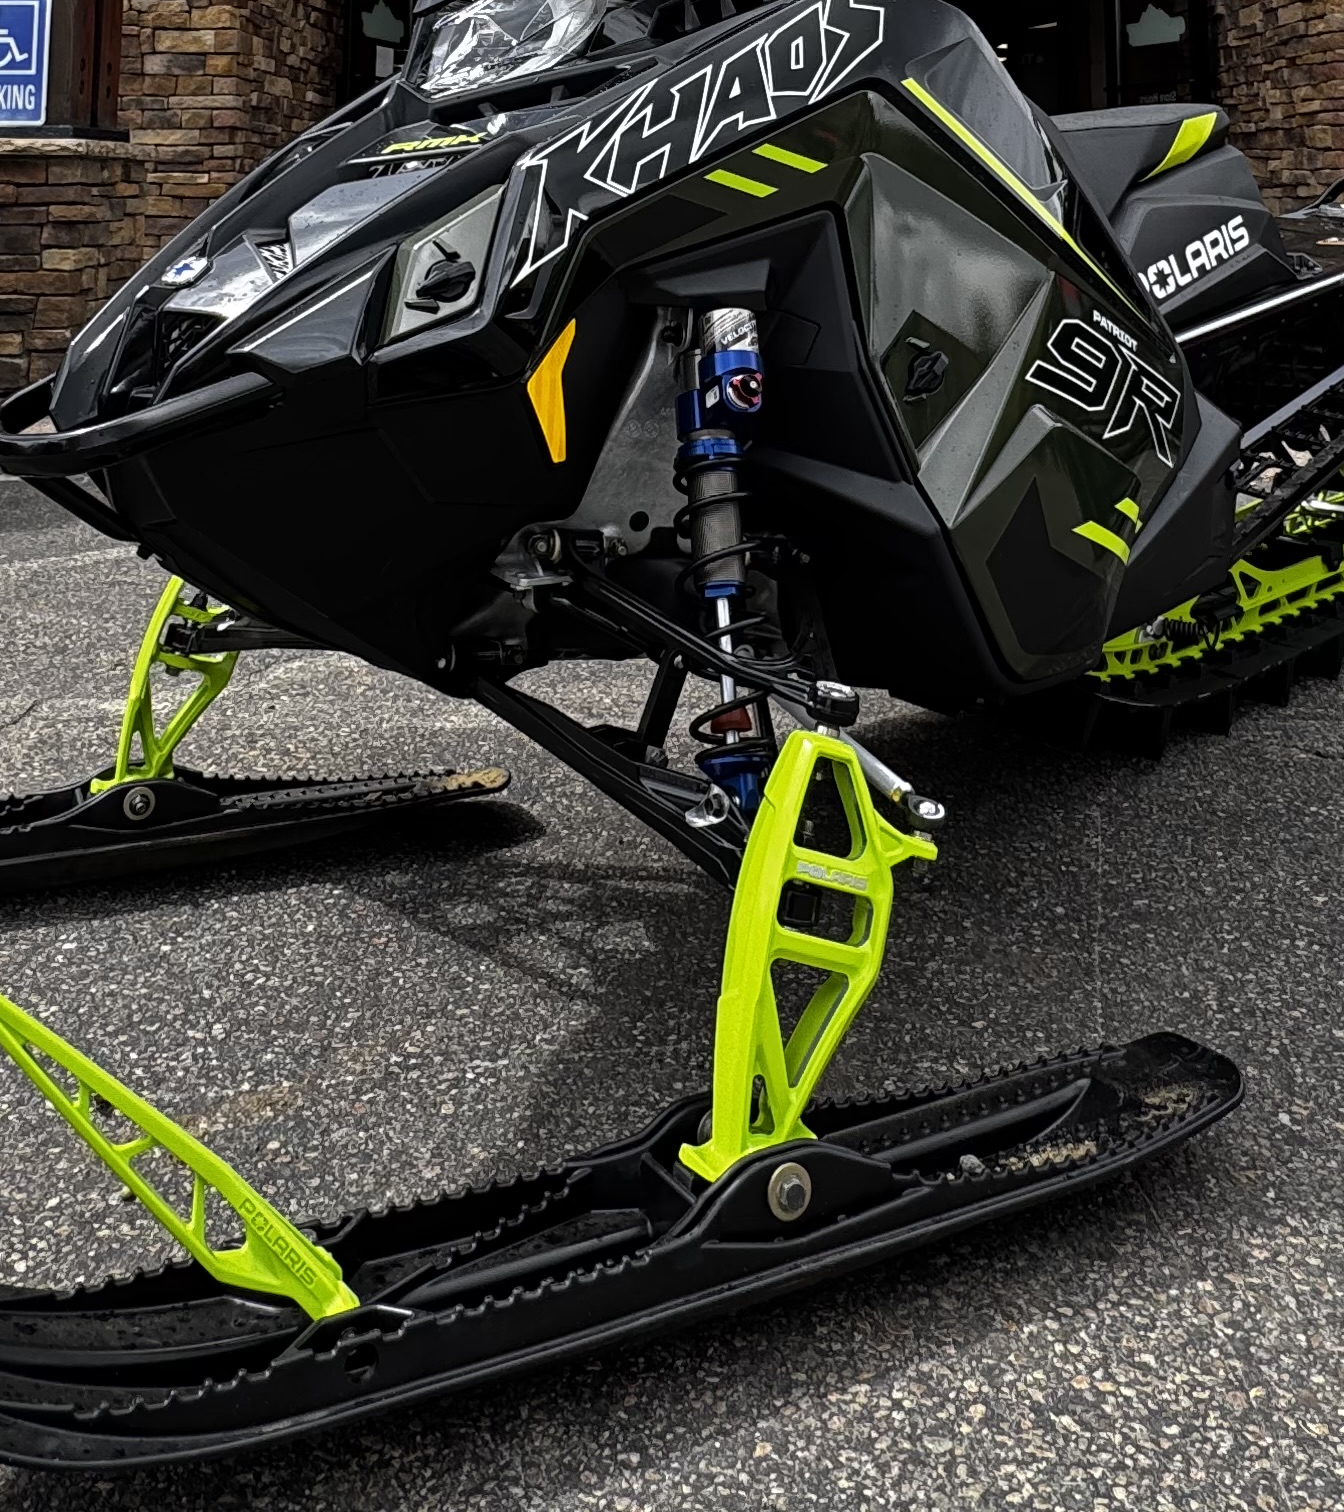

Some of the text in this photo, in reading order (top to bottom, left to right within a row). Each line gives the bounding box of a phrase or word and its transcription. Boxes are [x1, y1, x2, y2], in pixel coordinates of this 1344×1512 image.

[380, 131, 488, 155] RMK
[1093, 309, 1138, 352] PATRIOT
[1025, 319, 1181, 468] 9R
[238, 1197, 318, 1287] POLARIS
